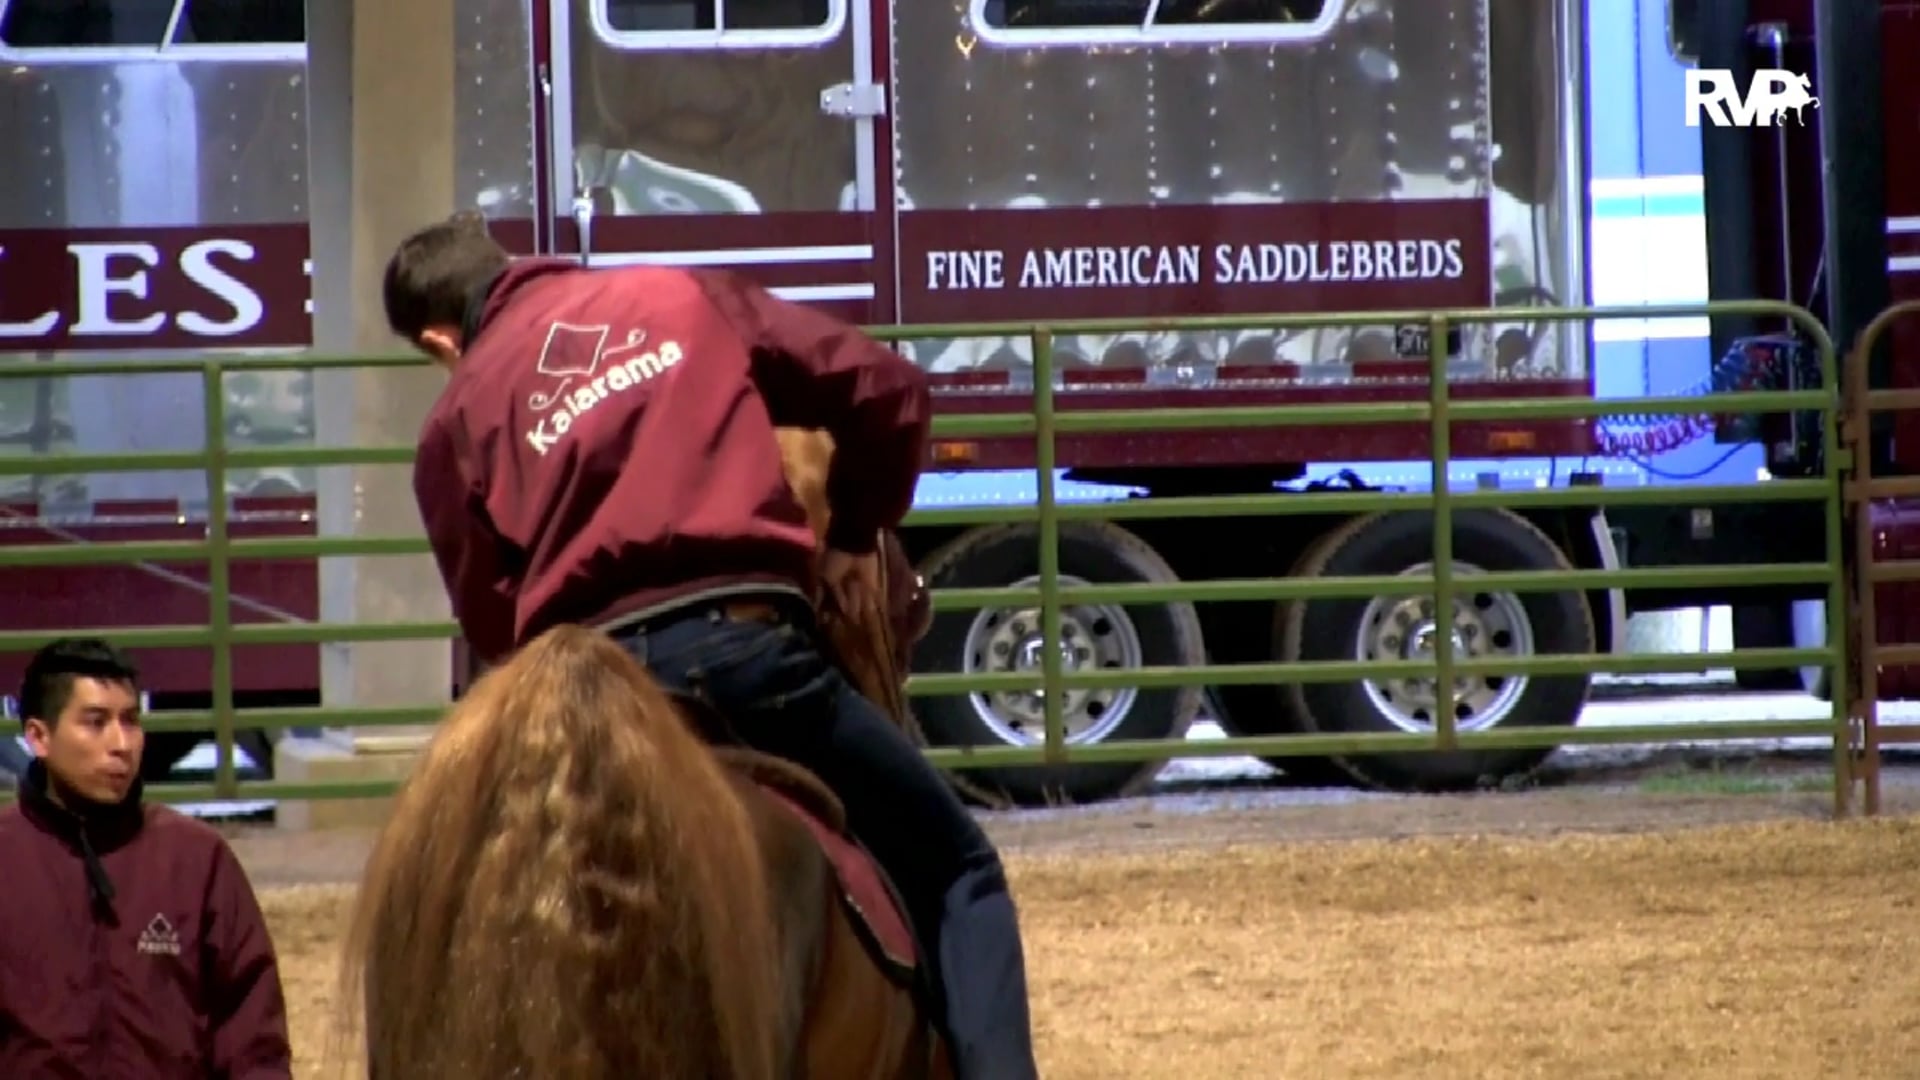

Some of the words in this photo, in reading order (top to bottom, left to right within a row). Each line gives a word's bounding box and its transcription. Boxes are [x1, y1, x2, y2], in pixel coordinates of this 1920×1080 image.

[926, 250, 1004, 289] FINE
[1018, 245, 1200, 288] AMERICAN
[1214, 239, 1463, 283] SADDLEBREDS
[526, 340, 683, 456] Kalarama
